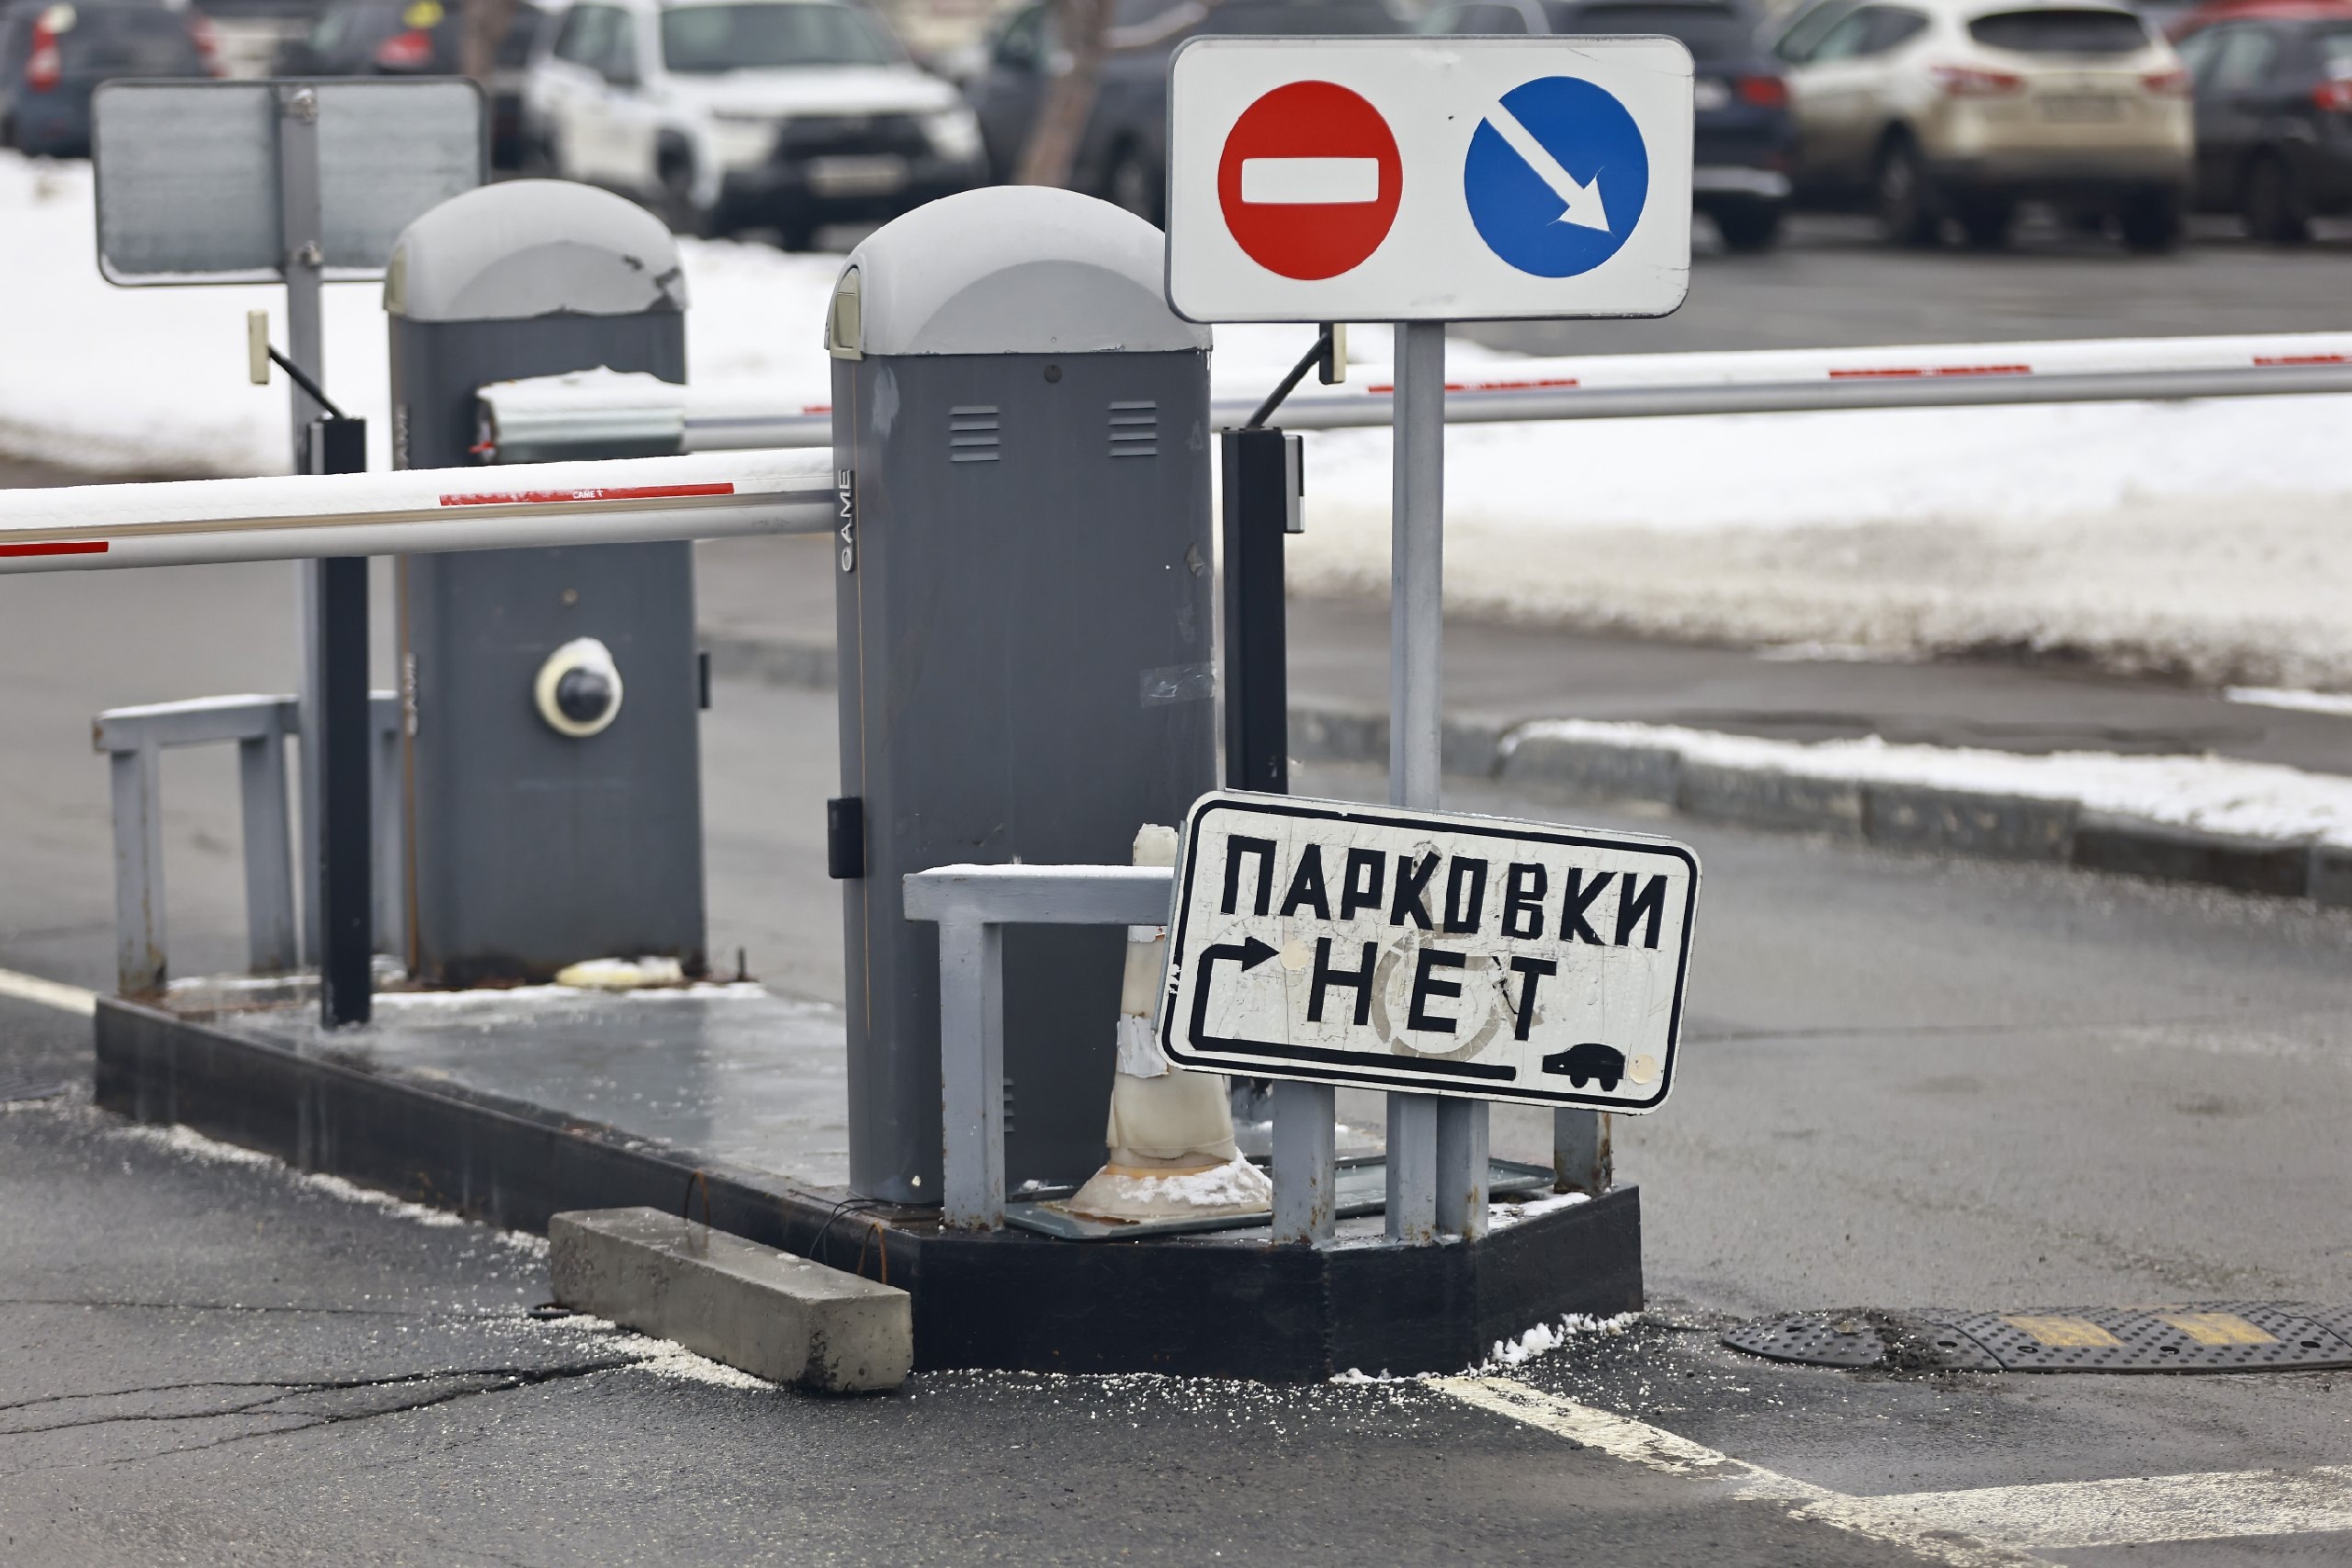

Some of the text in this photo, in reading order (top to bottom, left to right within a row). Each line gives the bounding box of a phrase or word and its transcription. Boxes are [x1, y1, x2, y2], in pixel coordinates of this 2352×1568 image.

[839, 469, 854, 571] CAME
[1221, 835, 1667, 948] ПАРКОВКИ
[1306, 938, 1556, 1040] НЕТ
